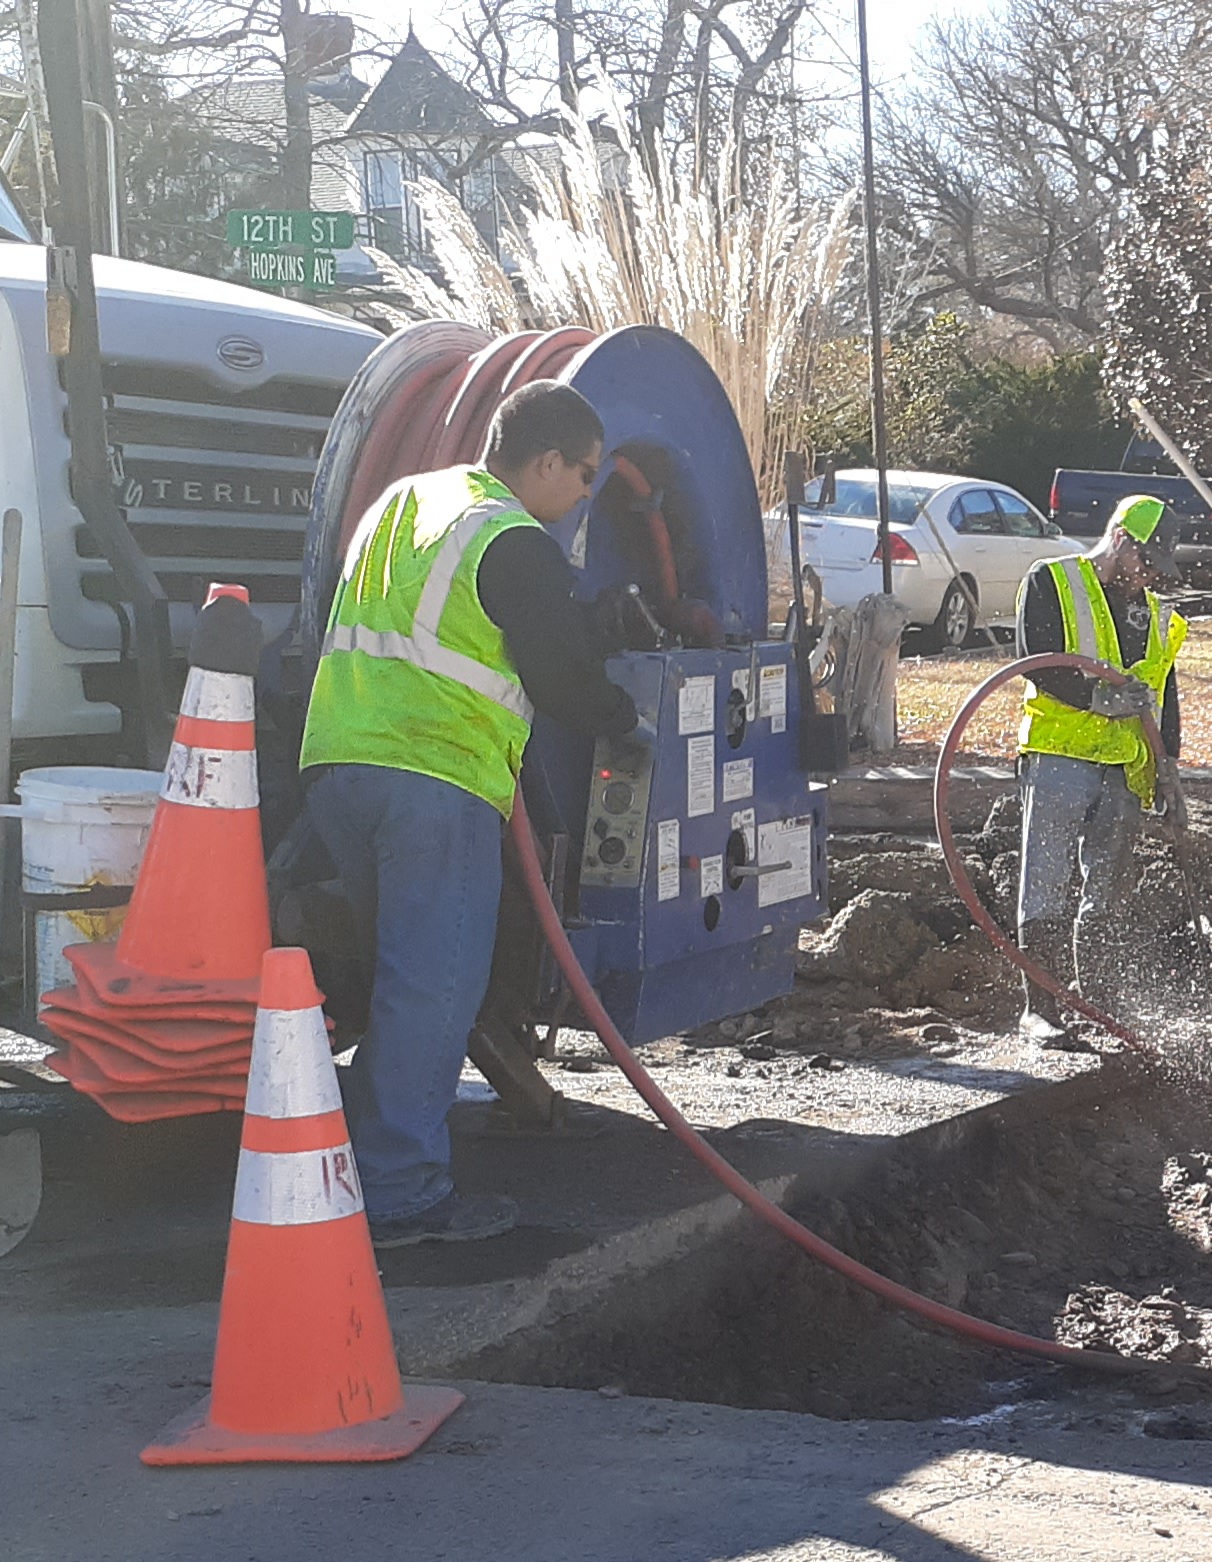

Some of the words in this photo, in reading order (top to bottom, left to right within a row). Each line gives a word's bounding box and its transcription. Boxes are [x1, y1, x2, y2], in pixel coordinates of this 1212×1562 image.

[242, 215, 293, 242] 12TH
[311, 216, 338, 243] ST
[251, 252, 305, 282] HOPKINS
[313, 257, 335, 285] AVE
